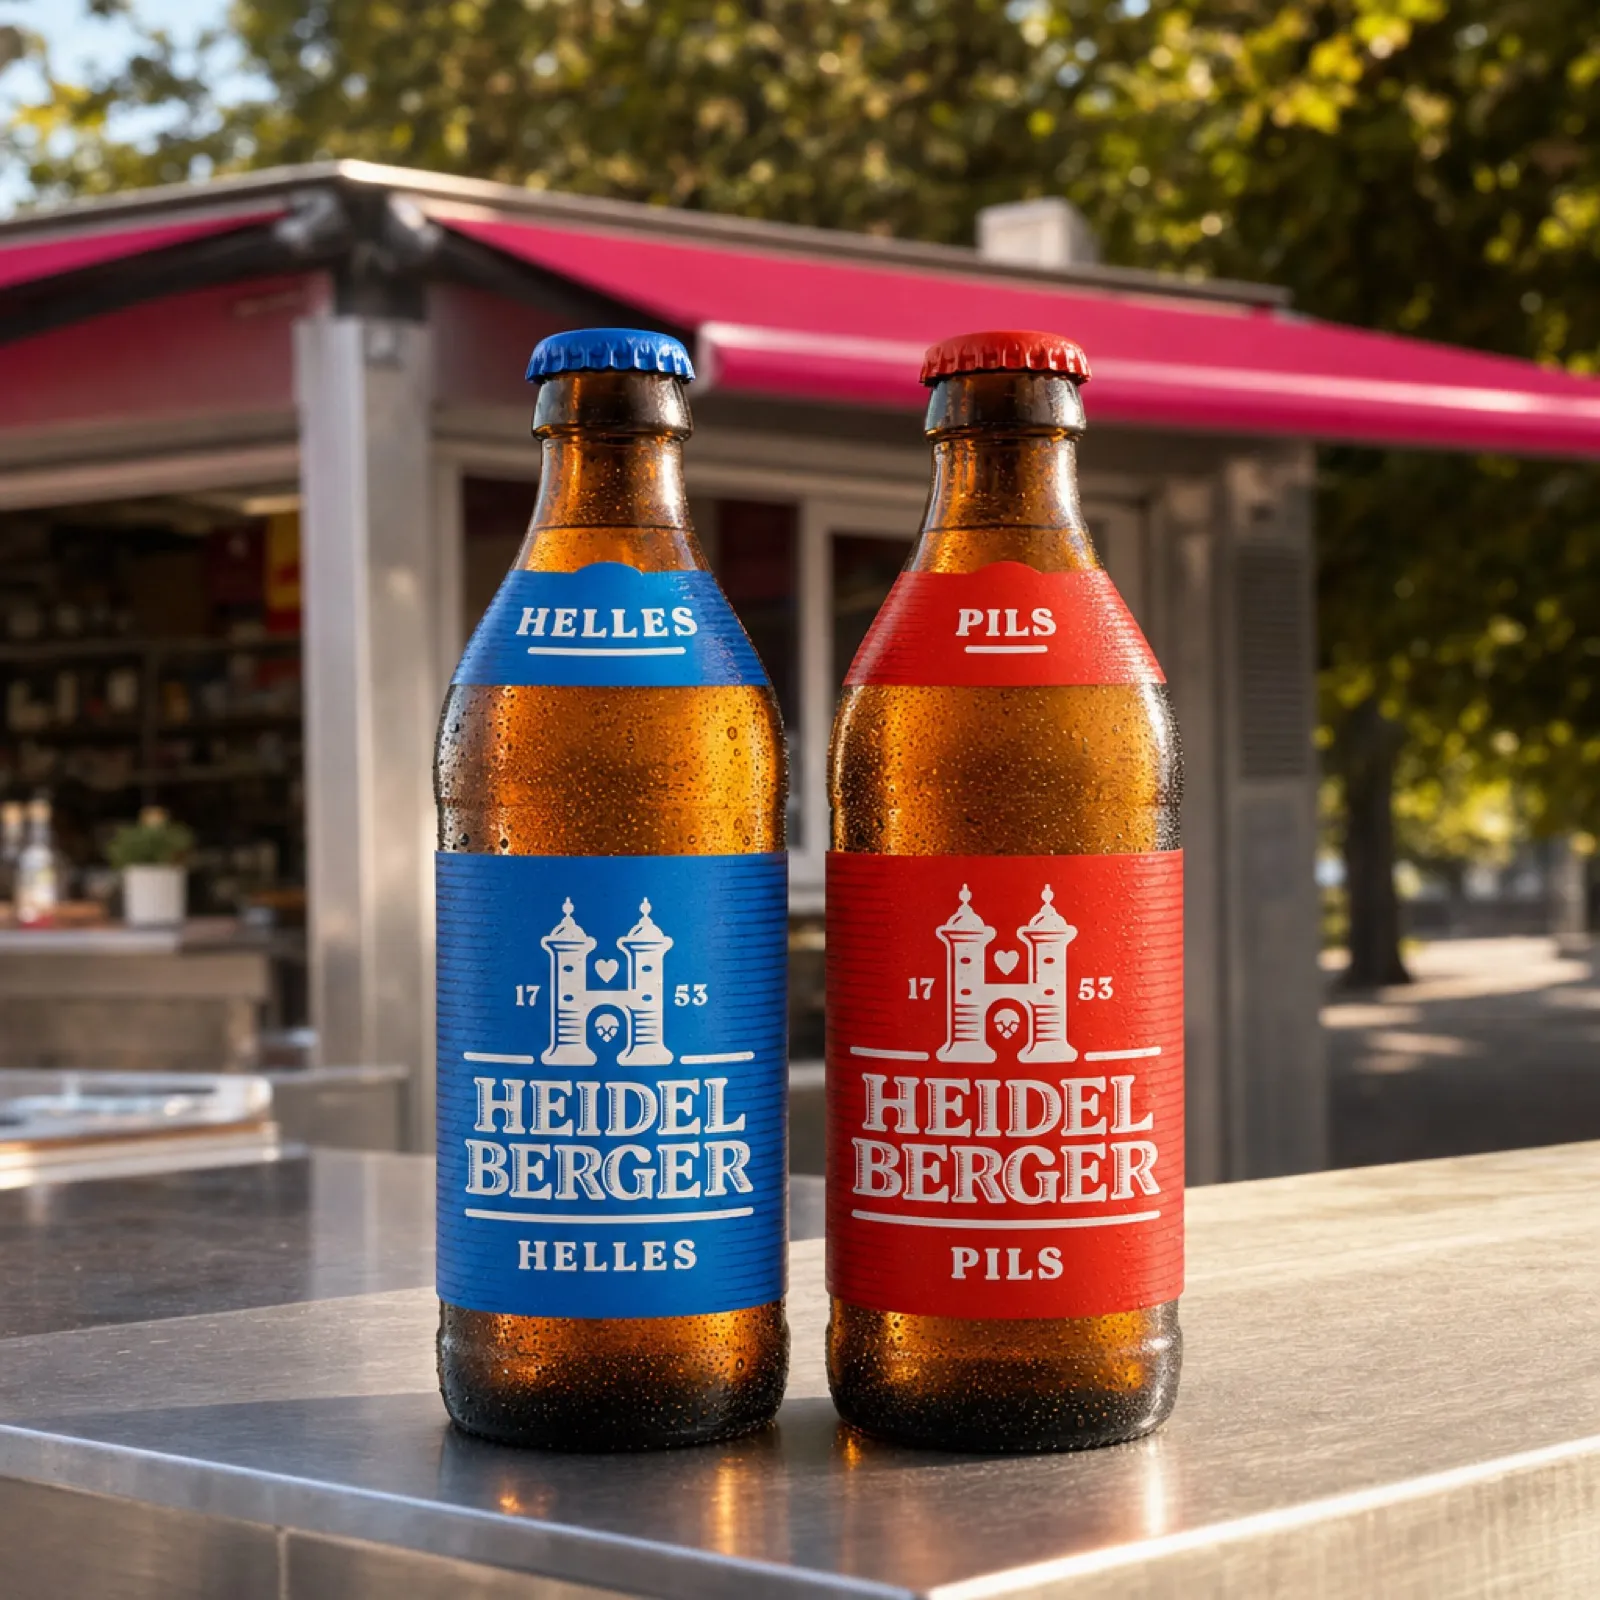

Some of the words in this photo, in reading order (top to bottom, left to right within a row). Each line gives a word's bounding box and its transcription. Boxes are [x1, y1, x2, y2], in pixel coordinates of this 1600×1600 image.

[515, 606, 699, 638] HELLES
[955, 607, 1057, 637] PILS
[515, 985, 540, 1007] 17
[674, 983, 709, 1007] 53
[908, 977, 935, 1000] 17
[1077, 976, 1114, 1001] 53
[474, 1077, 745, 1136] HEIDEL
[862, 1074, 1153, 1137] HEIDEL
[465, 1139, 753, 1200] BERGER
[852, 1138, 1161, 1204] BERGER
[518, 1239, 697, 1272] HELLES
[951, 1246, 1064, 1280] PILS
